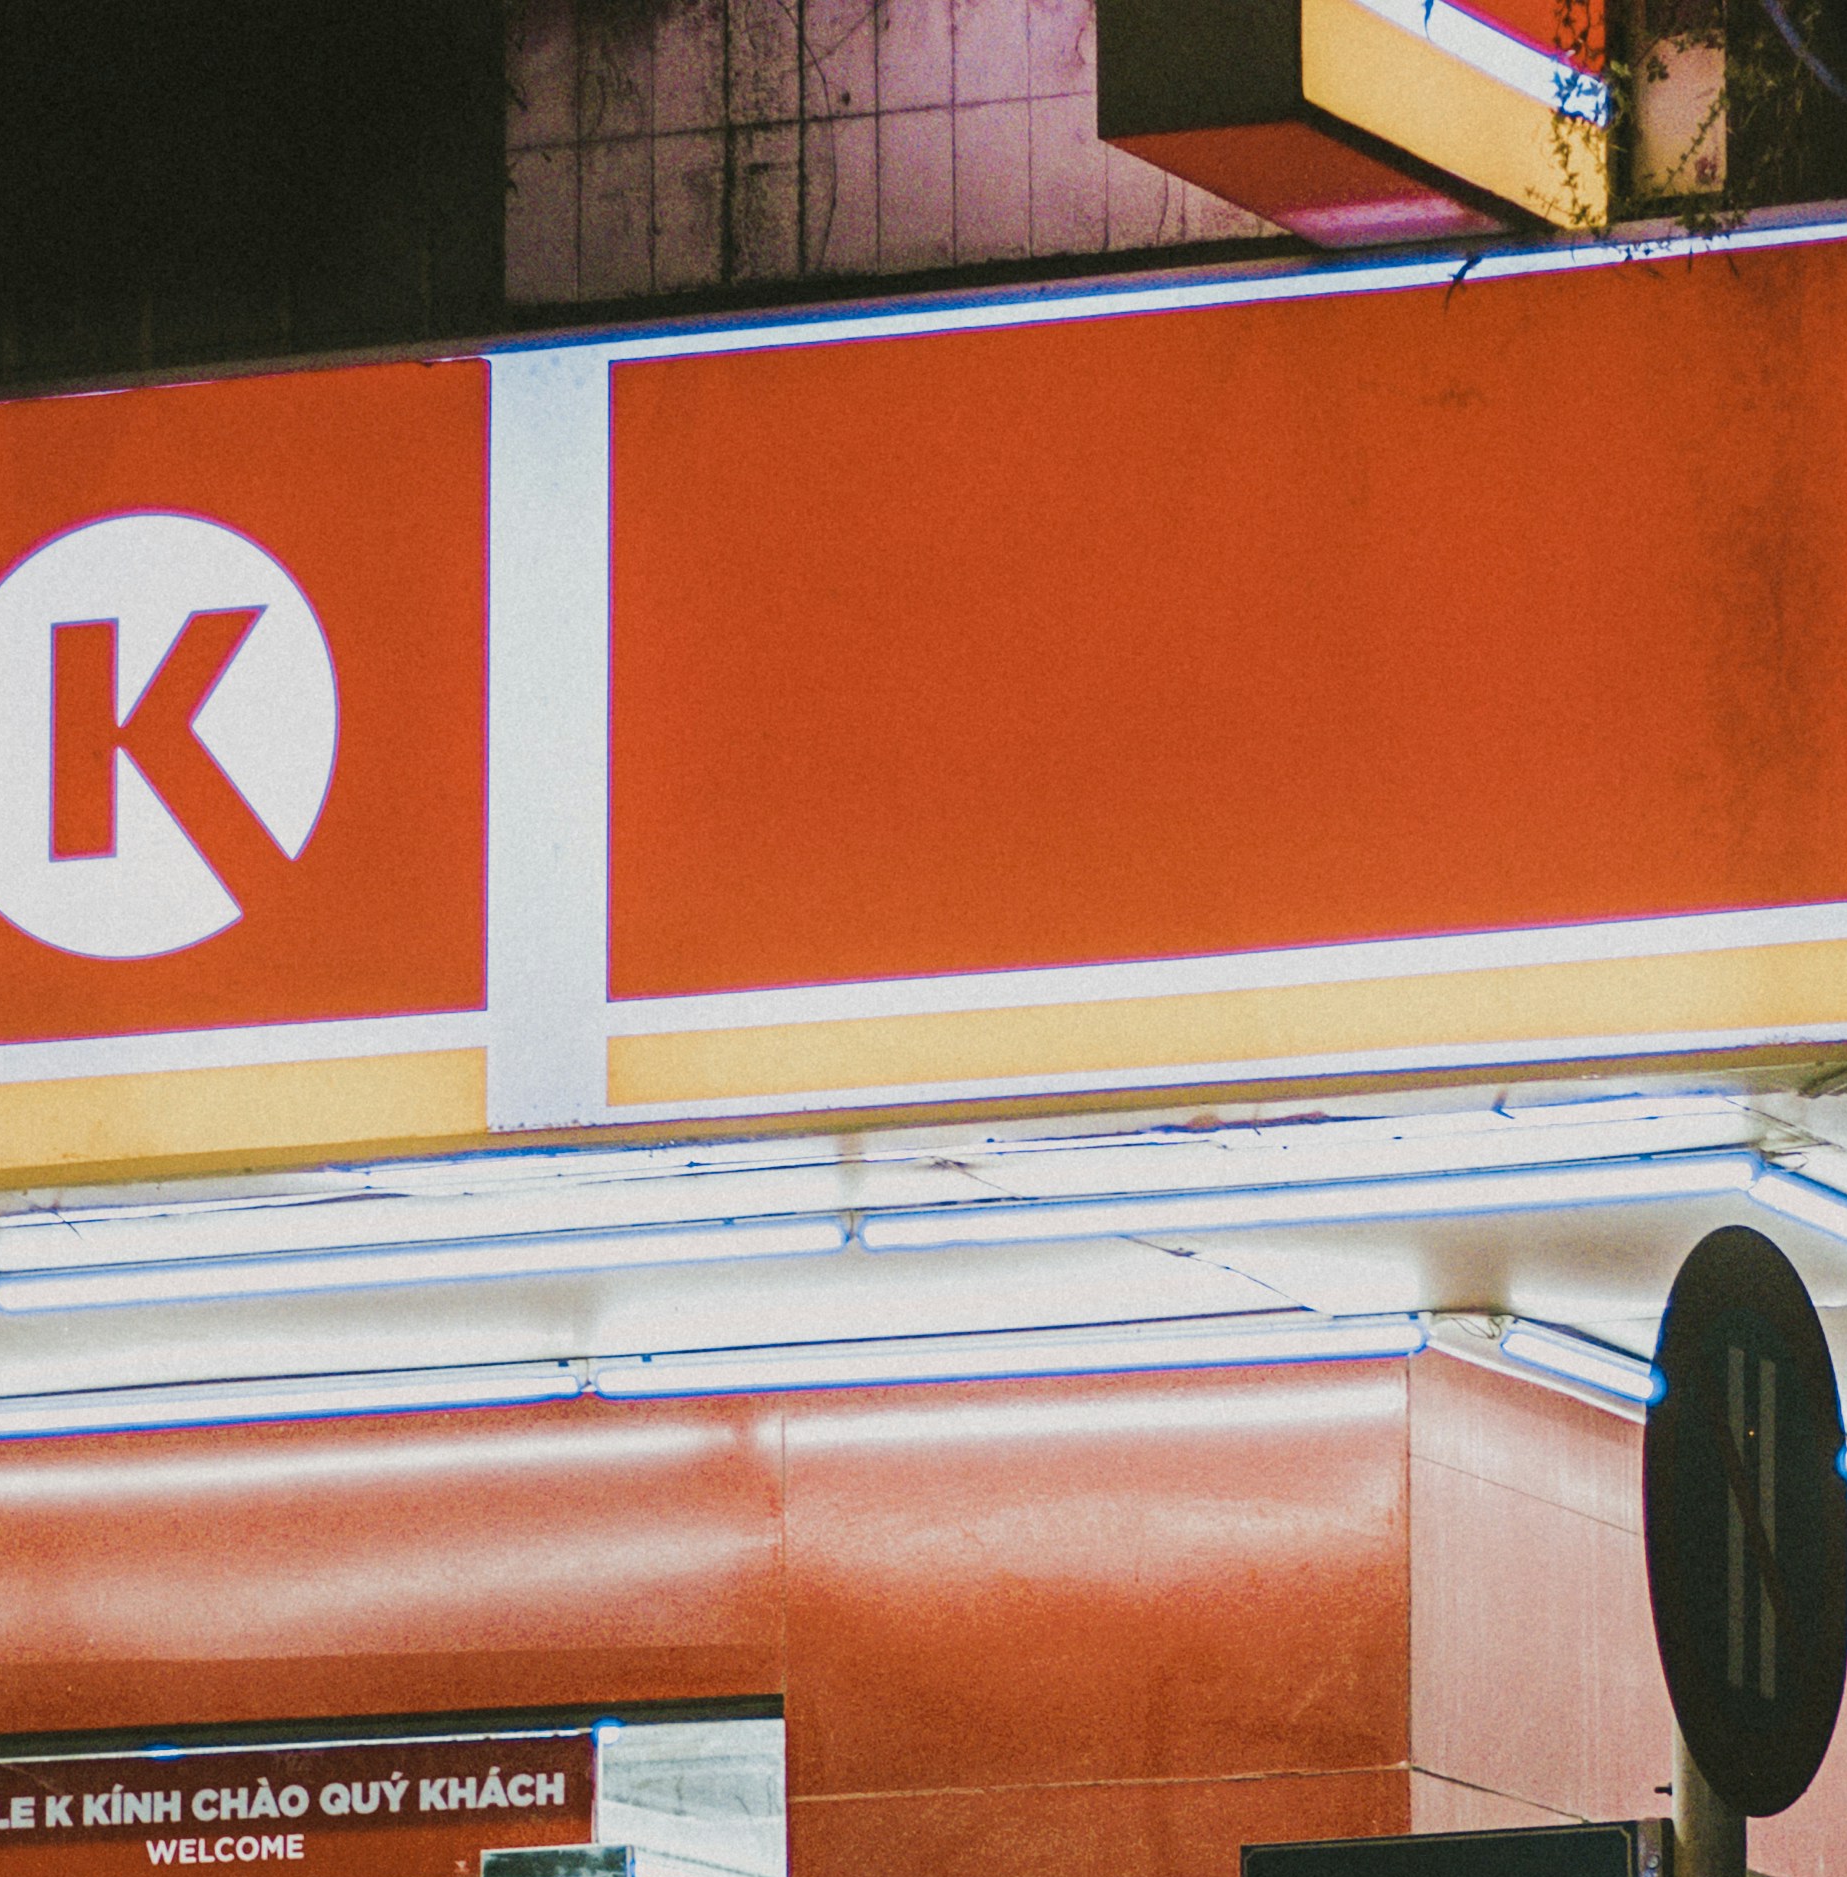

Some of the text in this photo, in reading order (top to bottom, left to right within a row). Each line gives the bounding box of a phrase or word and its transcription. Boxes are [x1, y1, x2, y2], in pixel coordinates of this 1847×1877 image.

[45, 1794, 74, 1829] K
[83, 1782, 181, 1826] KÍNH
[191, 1777, 309, 1822] CHÀO
[319, 1770, 409, 1816] QUÝ
[418, 1765, 565, 1814] KHÁCH
[146, 1834, 305, 1866] WELCOME
